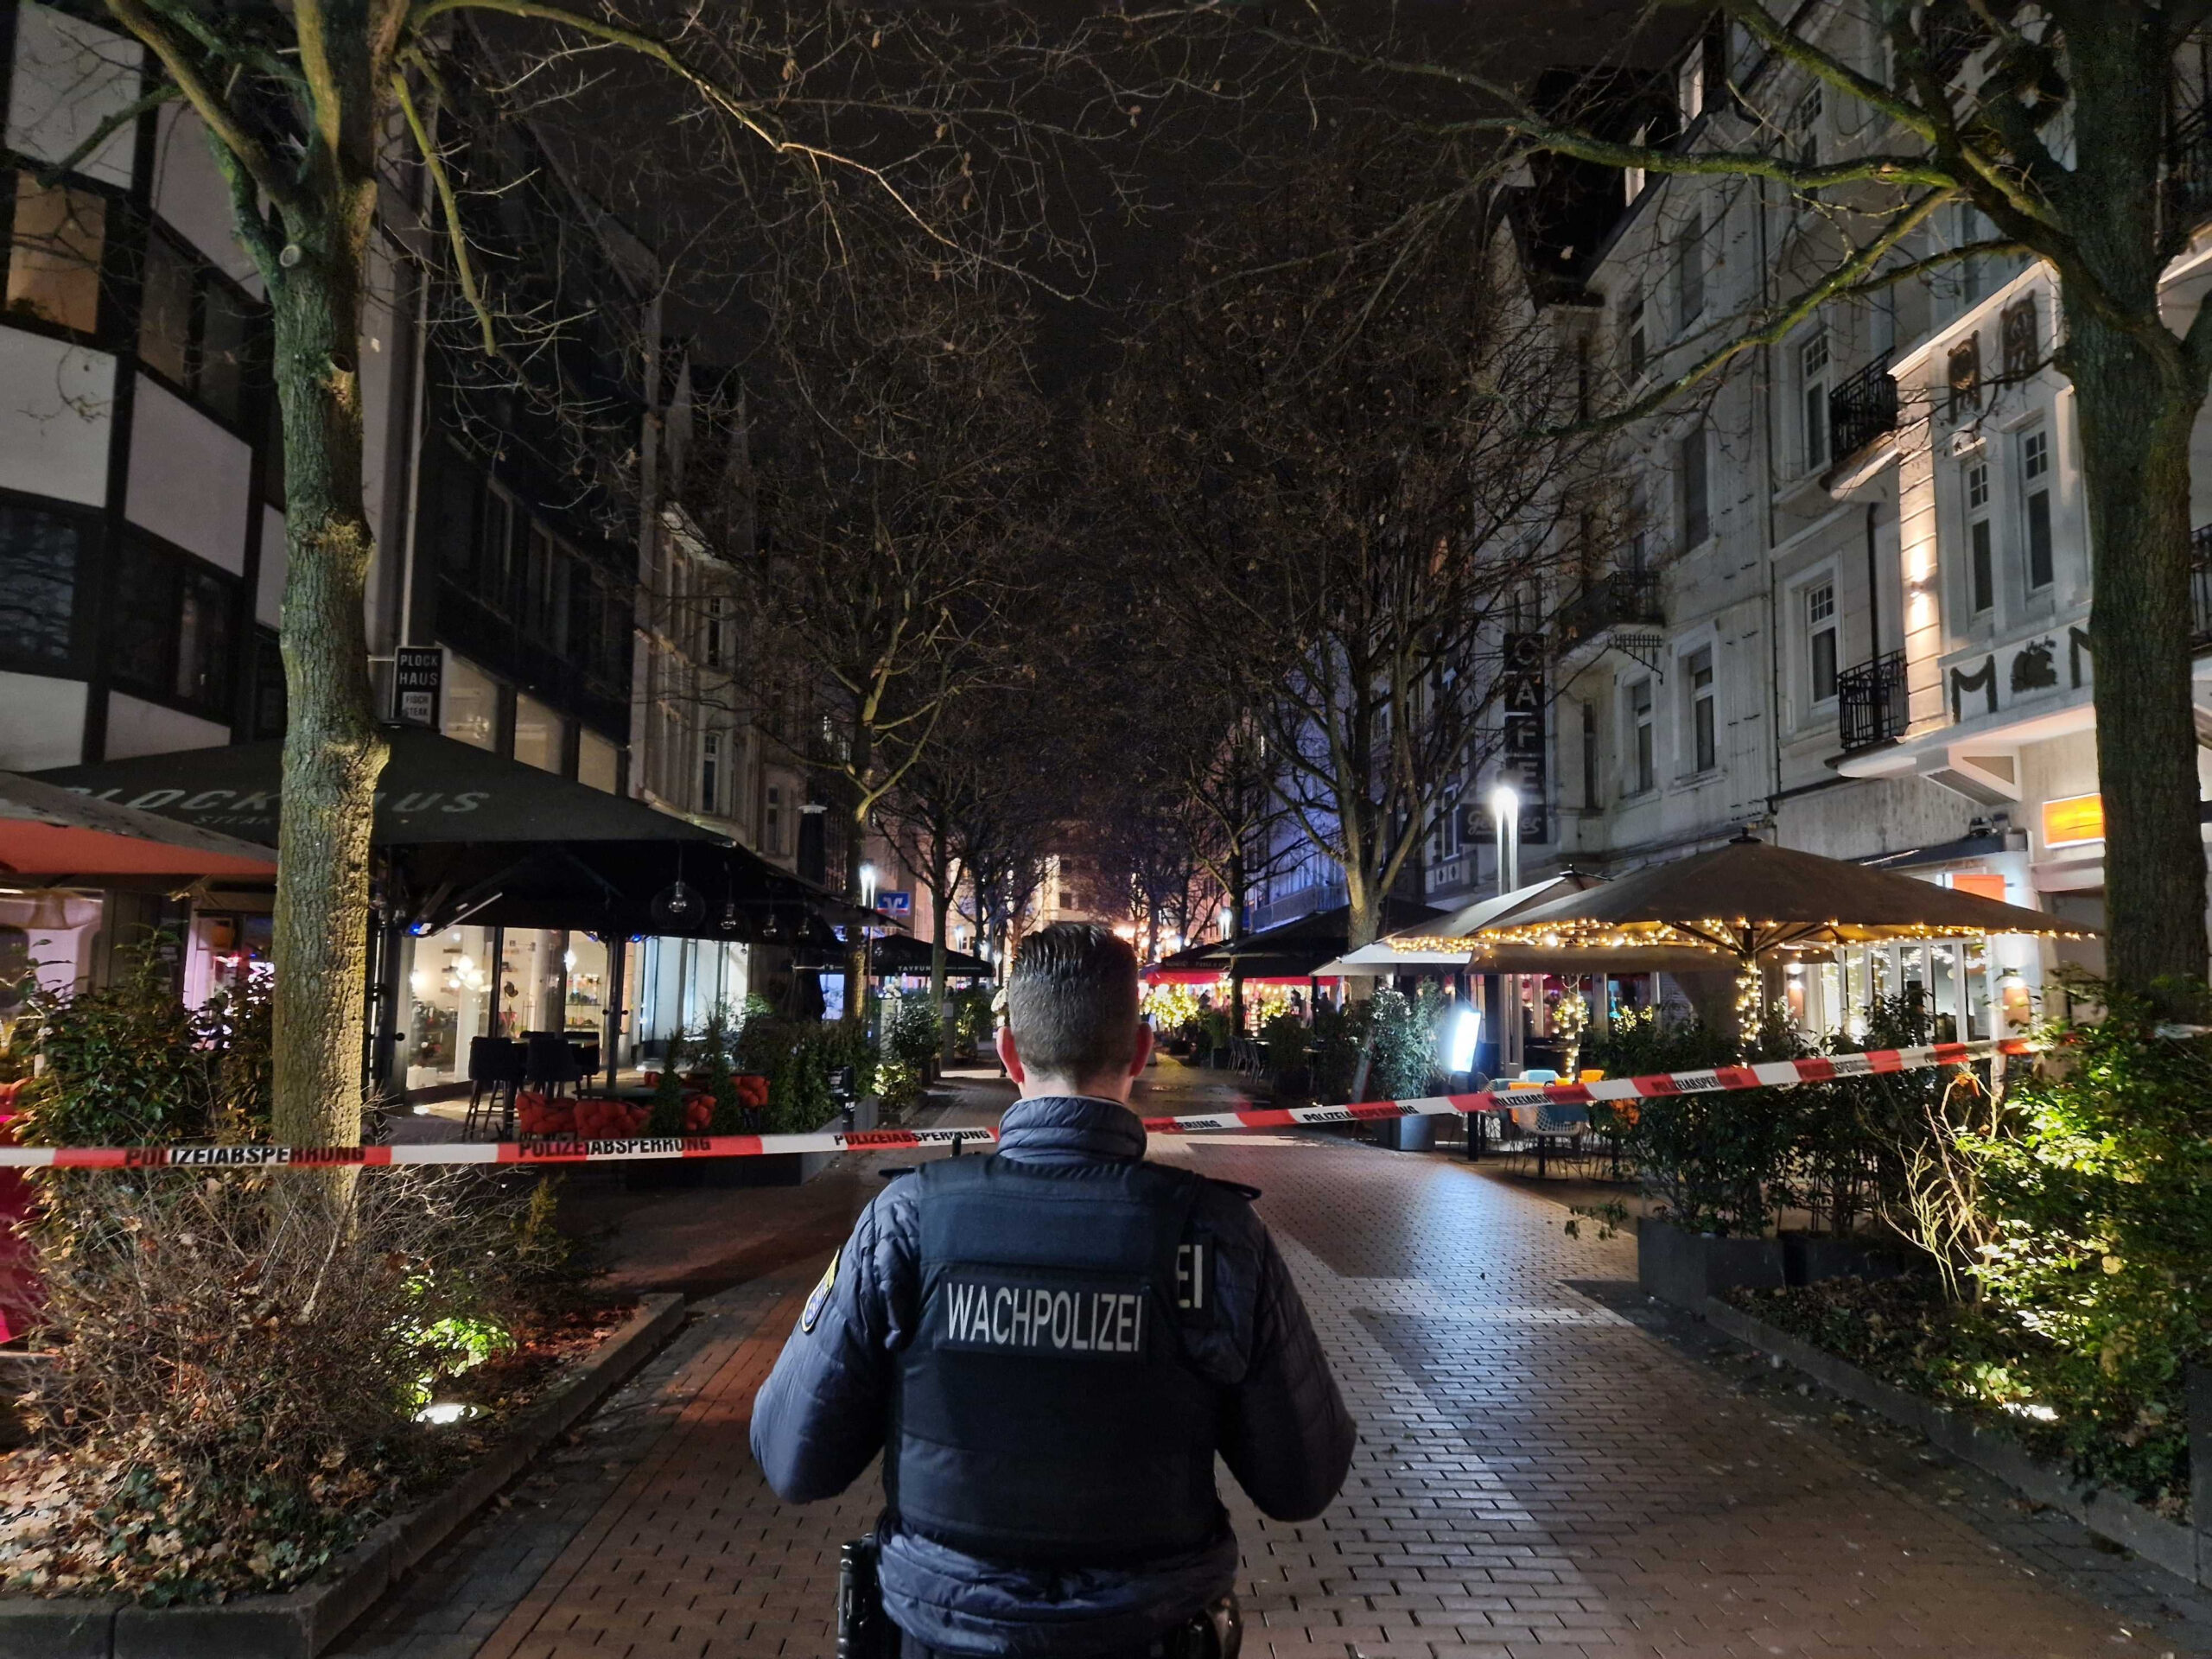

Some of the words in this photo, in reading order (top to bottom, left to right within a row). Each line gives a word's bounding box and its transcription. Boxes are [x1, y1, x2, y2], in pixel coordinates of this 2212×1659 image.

[400, 654, 438, 667] PLOCK
[399, 672, 438, 686] HAUS
[125, 1147, 365, 1166] POLIZEIABSPERRUNG
[519, 1136, 711, 1158] POLIZEIABSPERRUNG
[947, 1282, 1142, 1352] WACHPOLIZEI
